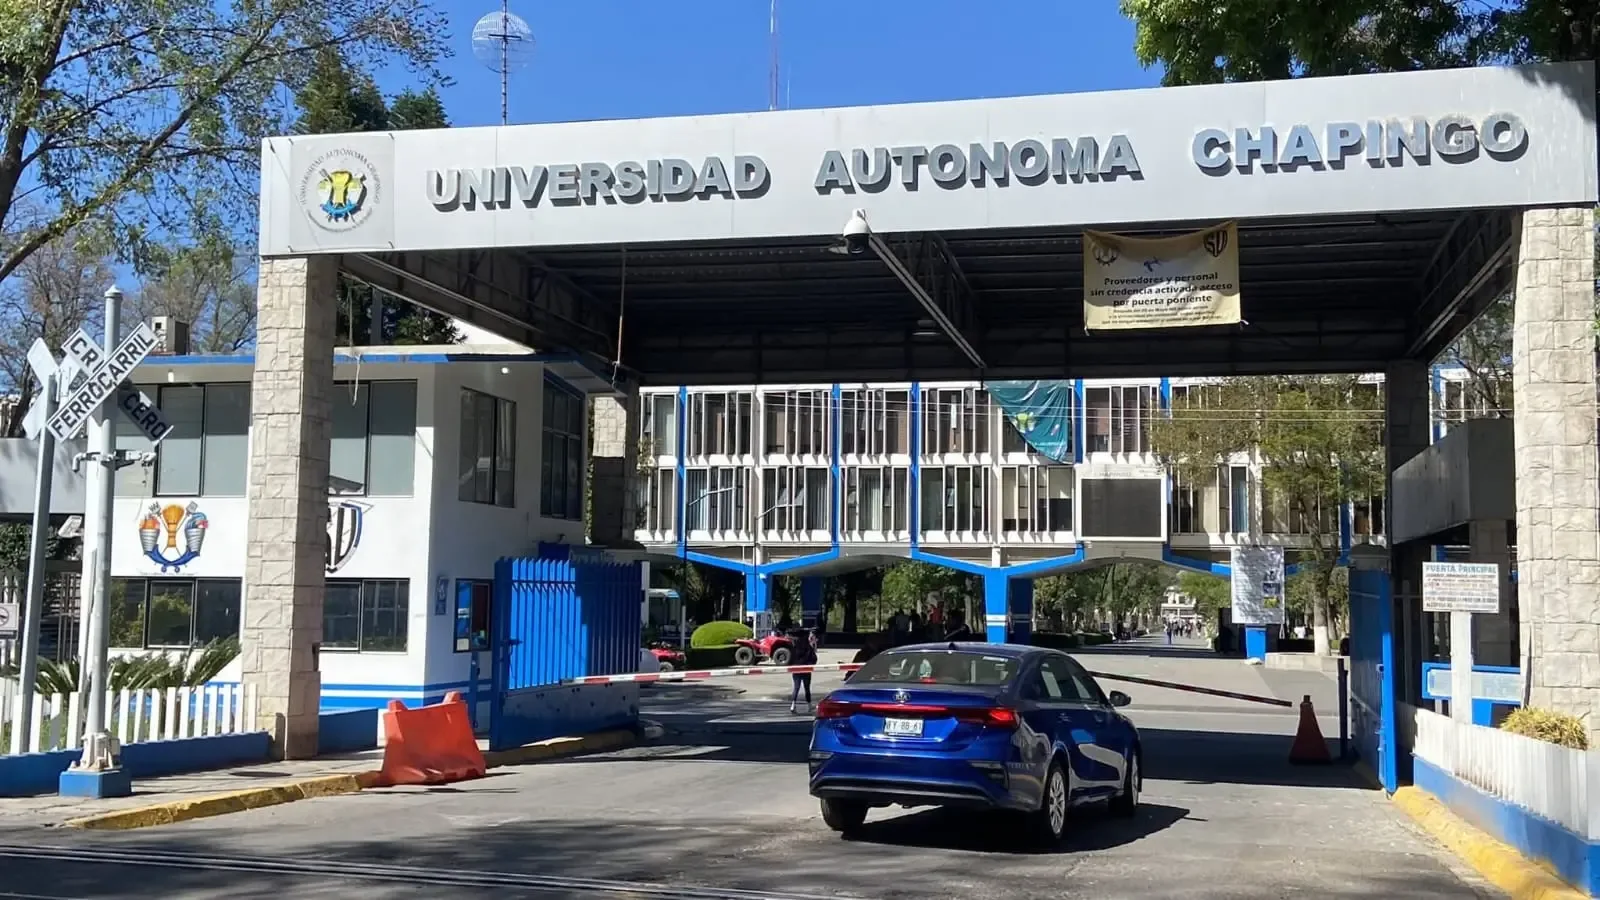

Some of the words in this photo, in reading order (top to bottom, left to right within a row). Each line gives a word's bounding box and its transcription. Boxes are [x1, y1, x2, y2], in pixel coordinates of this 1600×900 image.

[426, 155, 771, 212] UNIVERSIDAD
[814, 134, 1144, 195] AUTONOMA
[1191, 111, 1529, 177] CHAPINGO
[1090, 287, 1104, 297] sin
[1155, 282, 1198, 294] activada
[1200, 283, 1233, 291] acceso
[1104, 275, 1163, 286] Proveedores
[1174, 272, 1219, 284] personal
[1113, 300, 1129, 308] por
[1131, 297, 1165, 307] puerta
[1166, 294, 1213, 306] poniente
[51, 333, 154, 438] FERROCARRIL
[70, 337, 105, 374] CR
[123, 393, 168, 439] CERO
